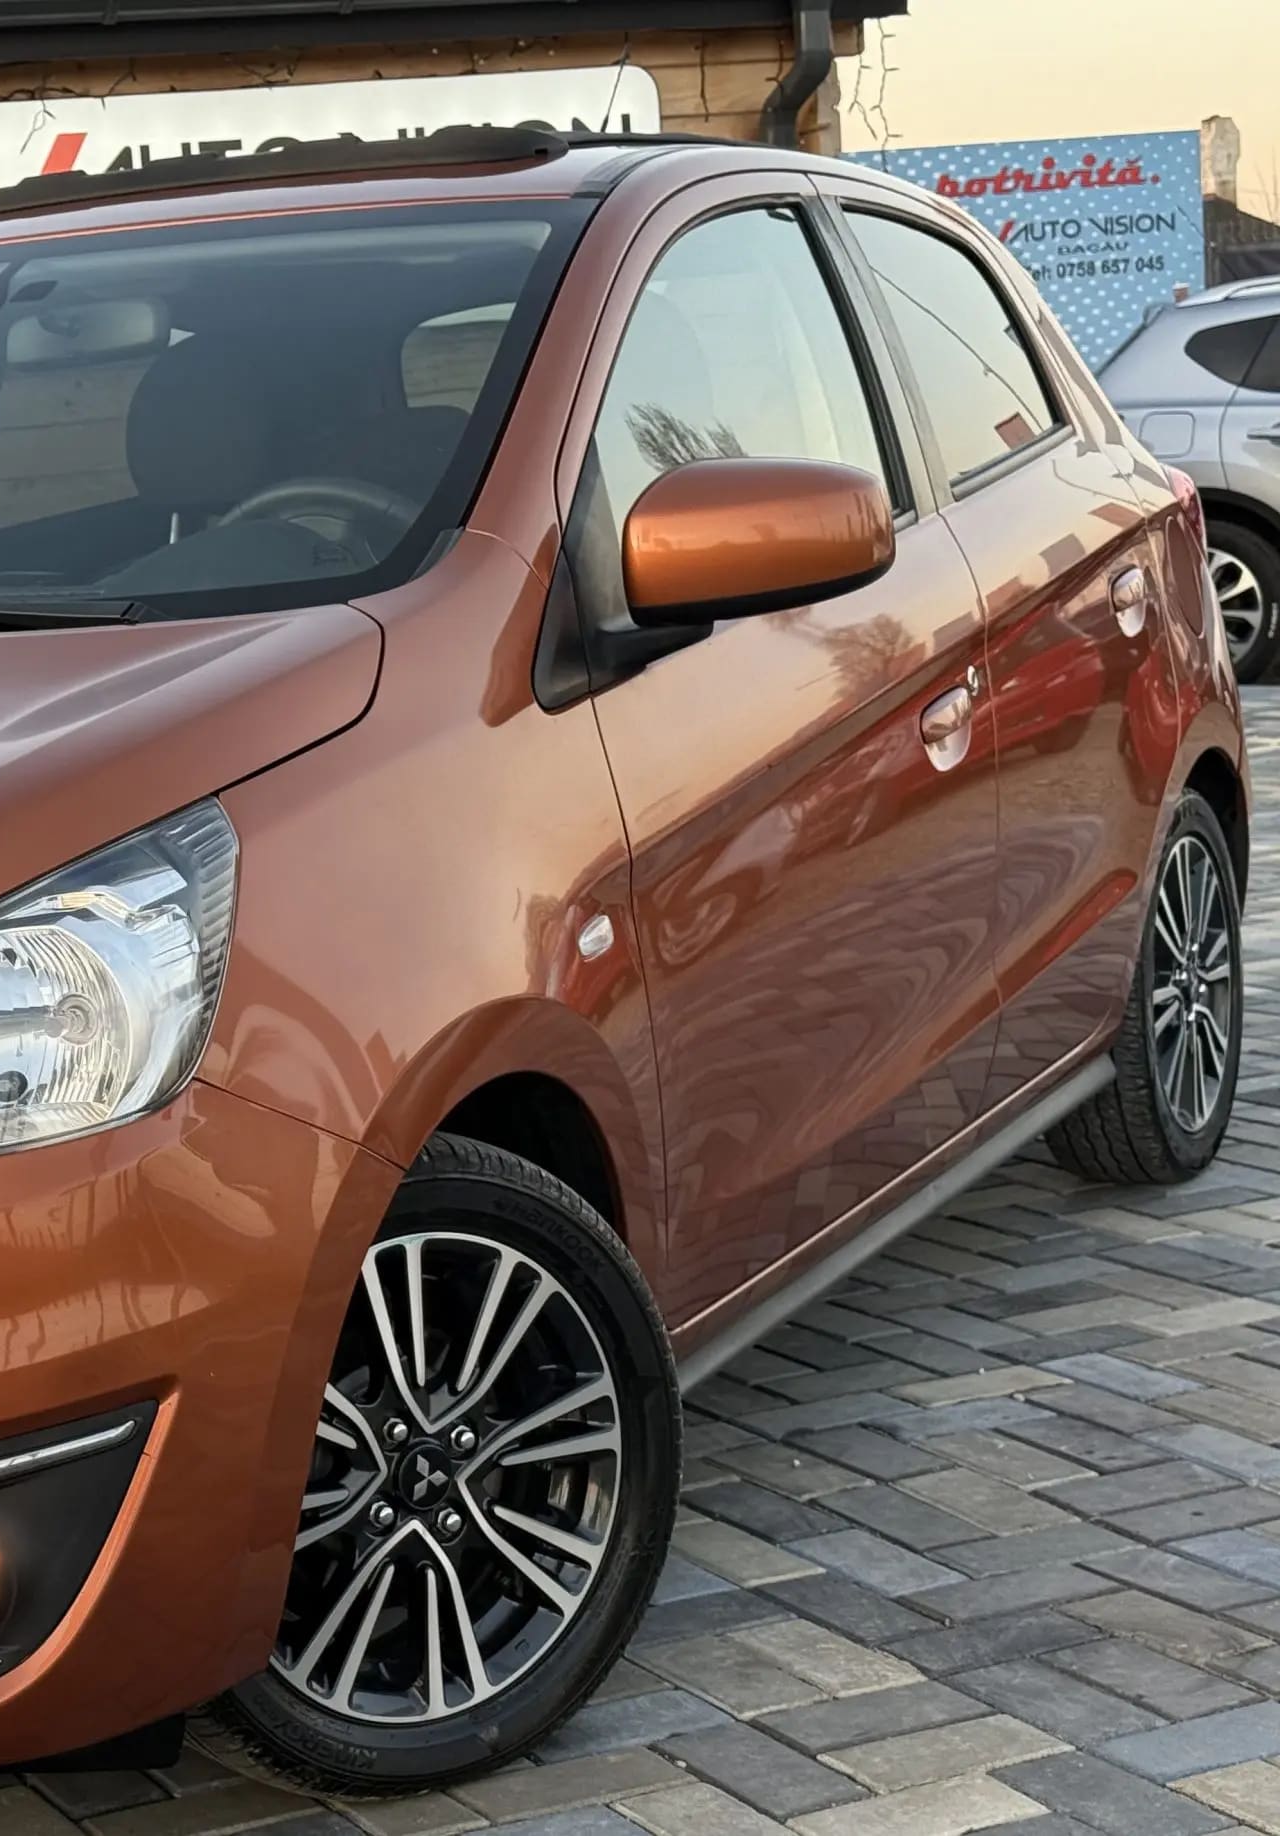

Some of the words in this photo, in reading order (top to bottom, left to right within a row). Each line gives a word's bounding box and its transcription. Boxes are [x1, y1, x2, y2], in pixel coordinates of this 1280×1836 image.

[1009, 218, 1082, 244] AUTO
[1087, 213, 1177, 238] VISION
[1056, 260, 1096, 279] 0758
[1101, 257, 1130, 274] 657
[1135, 254, 1165, 272] 045
